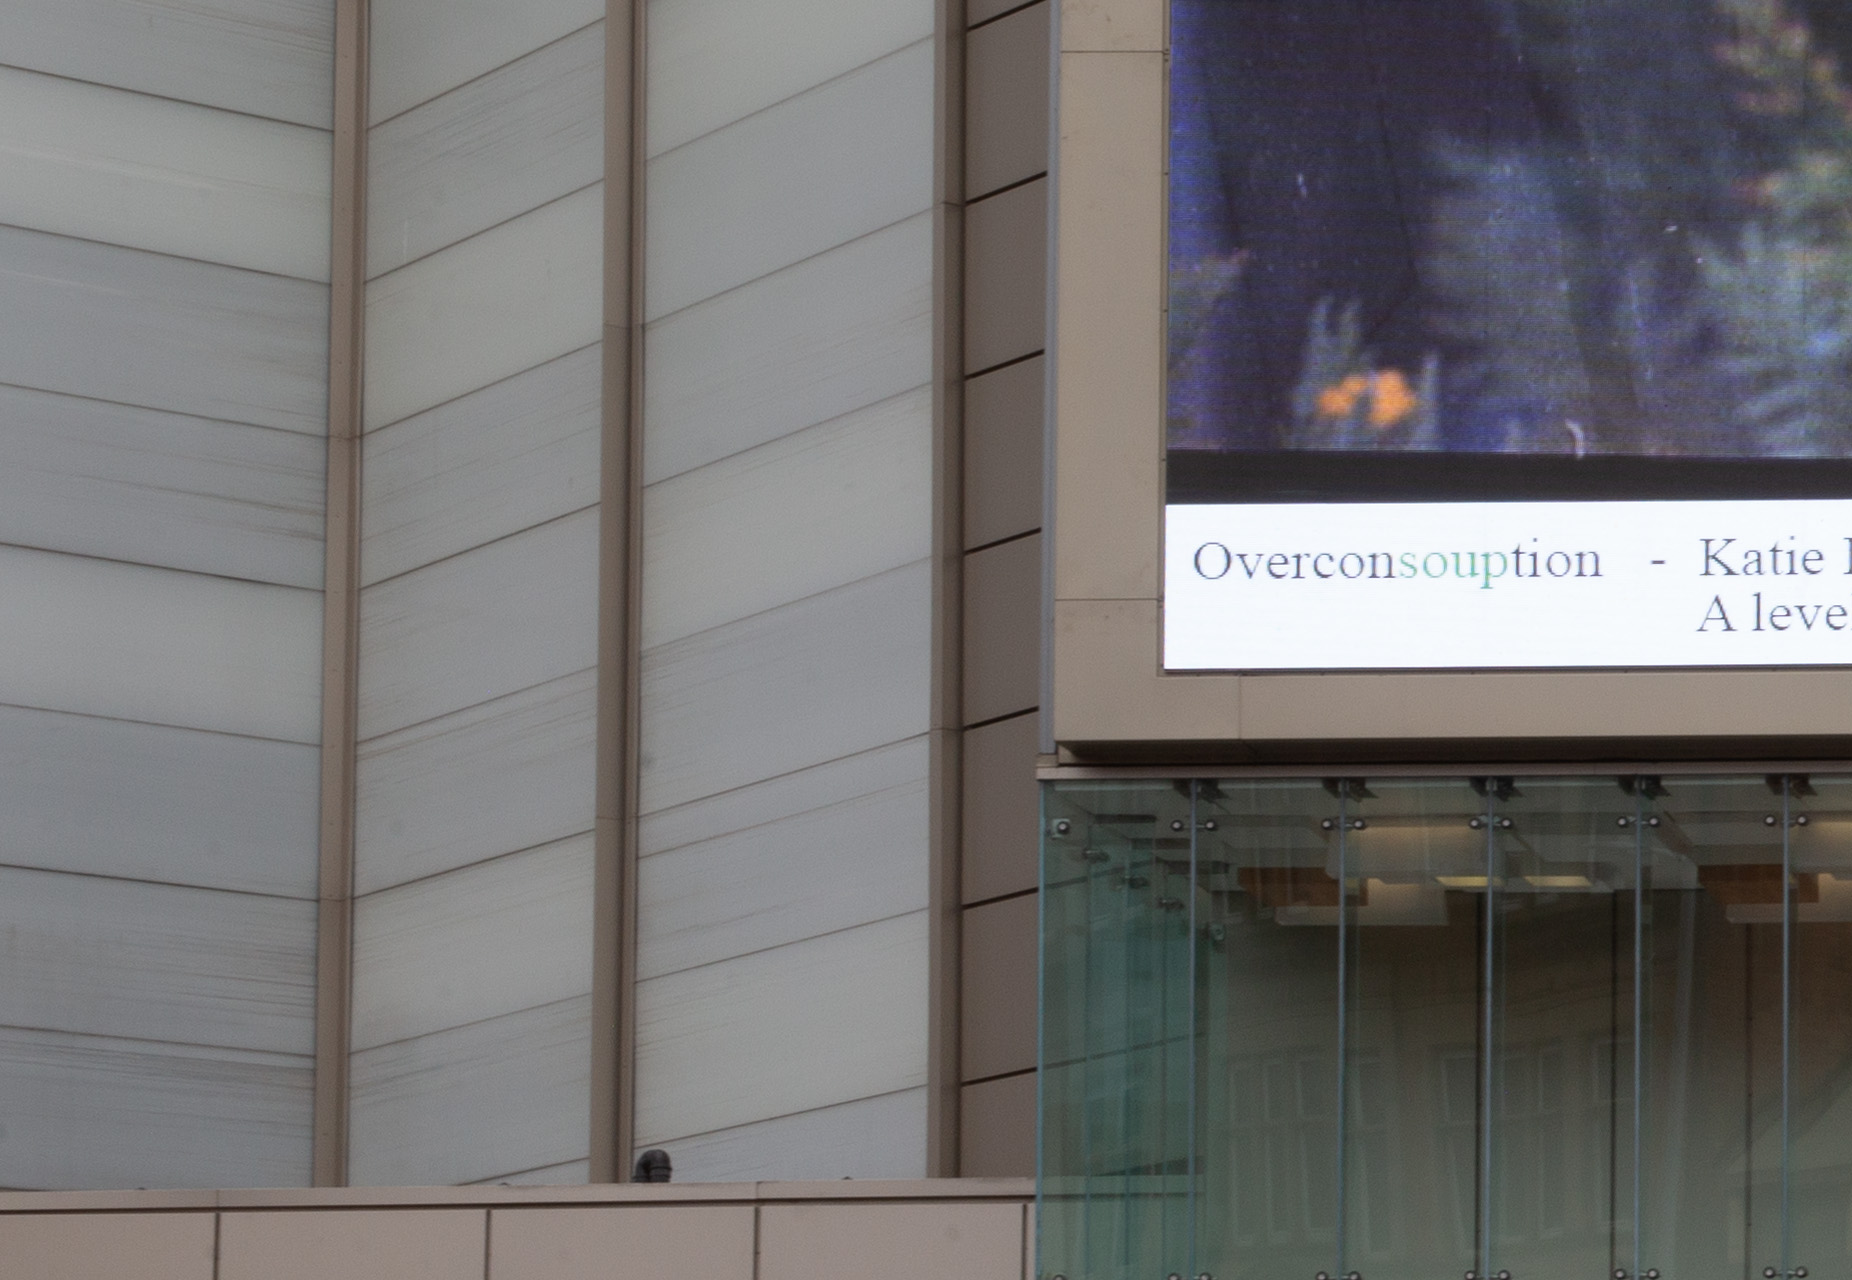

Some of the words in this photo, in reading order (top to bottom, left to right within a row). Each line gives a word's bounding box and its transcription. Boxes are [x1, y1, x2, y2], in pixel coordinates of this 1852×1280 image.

[1193, 537, 1602, 588] Overconsouption
[1699, 535, 1824, 578] Katie
[1697, 593, 1736, 634] A
